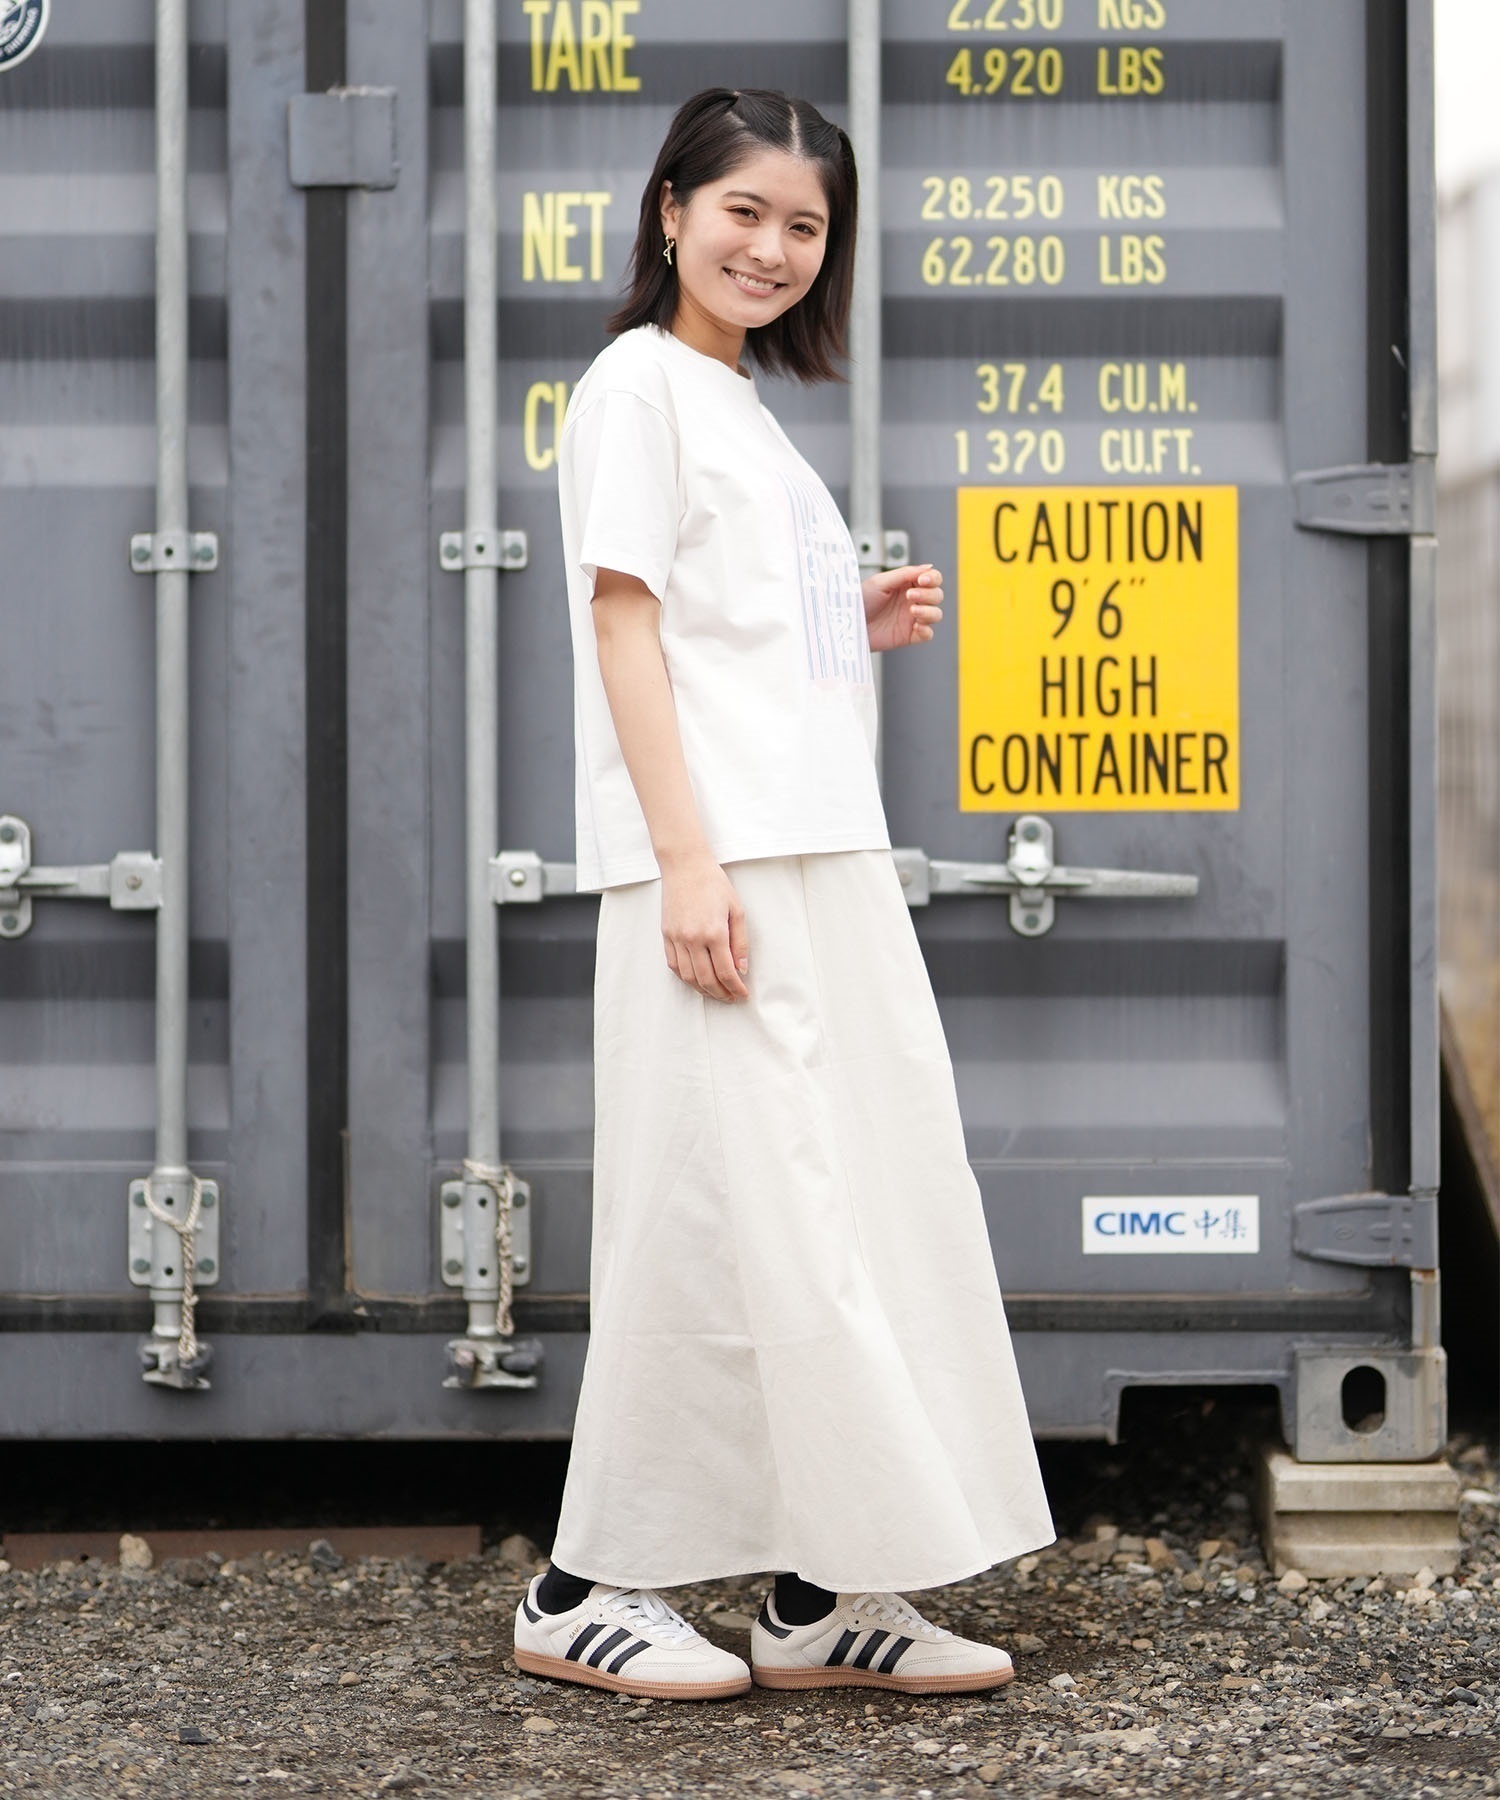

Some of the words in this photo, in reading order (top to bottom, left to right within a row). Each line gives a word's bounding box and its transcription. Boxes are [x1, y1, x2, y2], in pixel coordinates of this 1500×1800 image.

[1098, 0, 1166, 30] KGS
[522, 0, 642, 92] TARE
[945, 47, 1064, 95] 4.920
[1097, 47, 1165, 95] LBS
[921, 175, 1064, 221] 28.250
[1098, 175, 1167, 220] KGS
[521, 192, 611, 282] NET
[921, 235, 1065, 286] 62.280
[1099, 234, 1167, 285] LBS
[976, 363, 1064, 414] 37.4
[1098, 362, 1199, 414] CU.M.
[1099, 428, 1202, 476] CU.FT.
[992, 501, 1205, 564] CAUTION
[1041, 656, 1158, 718] HIGH
[970, 732, 1230, 797] CONTAINER
[1094, 1212, 1187, 1236] CIMC
[1193, 1208, 1249, 1240] 中集
